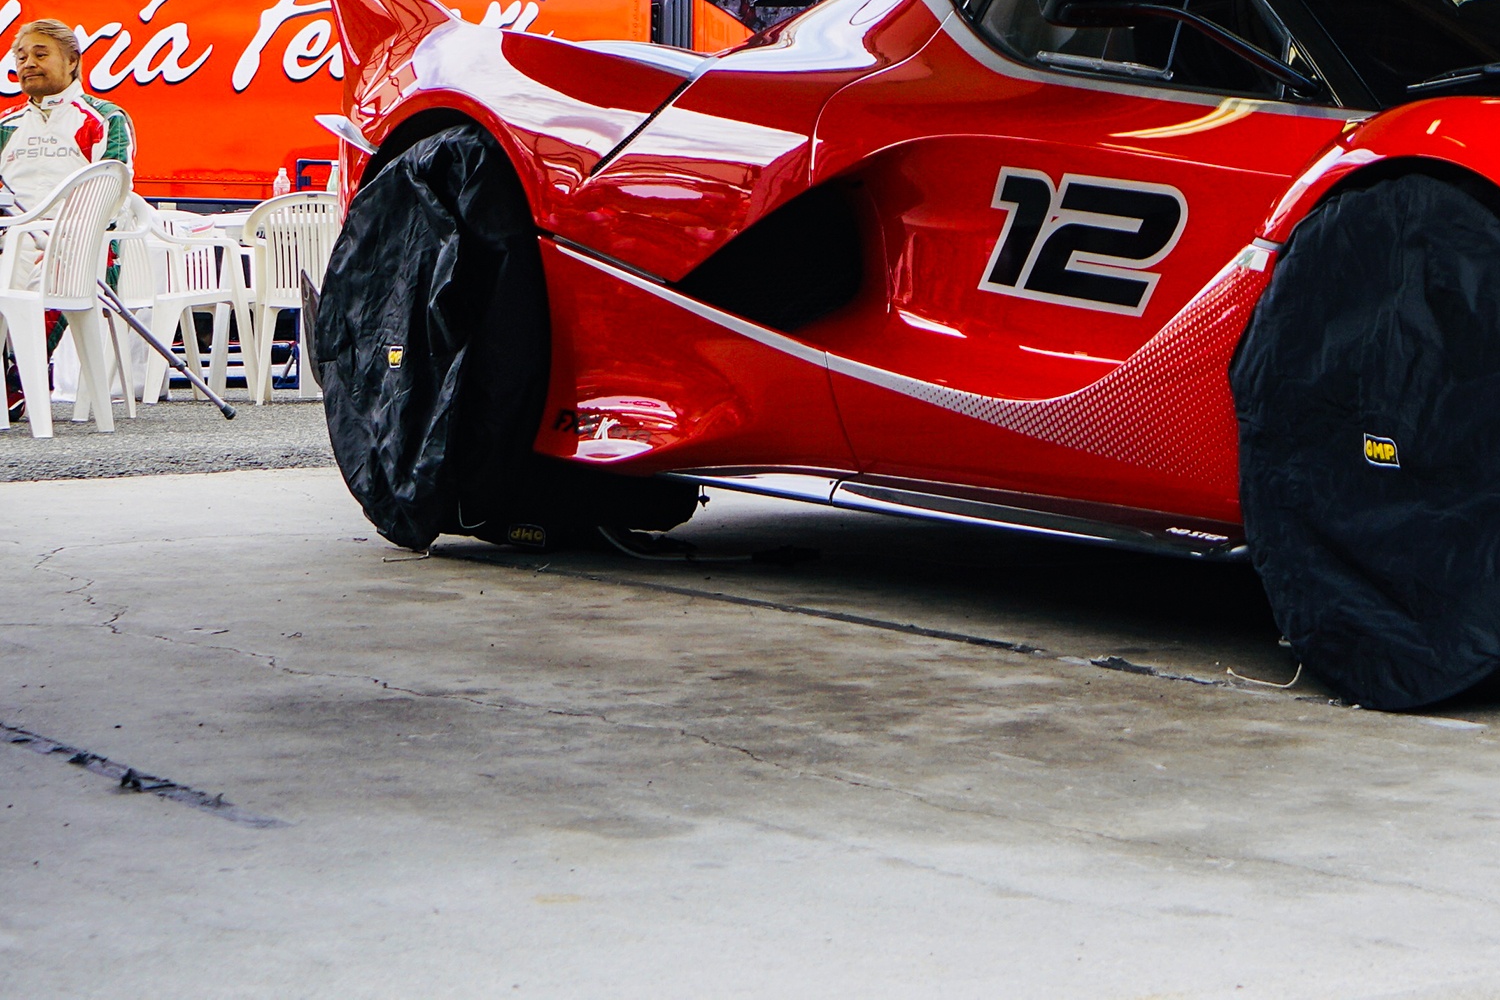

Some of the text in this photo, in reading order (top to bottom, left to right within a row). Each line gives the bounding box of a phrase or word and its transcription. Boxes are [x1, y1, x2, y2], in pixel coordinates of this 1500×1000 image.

[27, 136, 58, 146] Club
[977, 166, 1189, 317] 12
[1366, 439, 1395, 460] OMP
